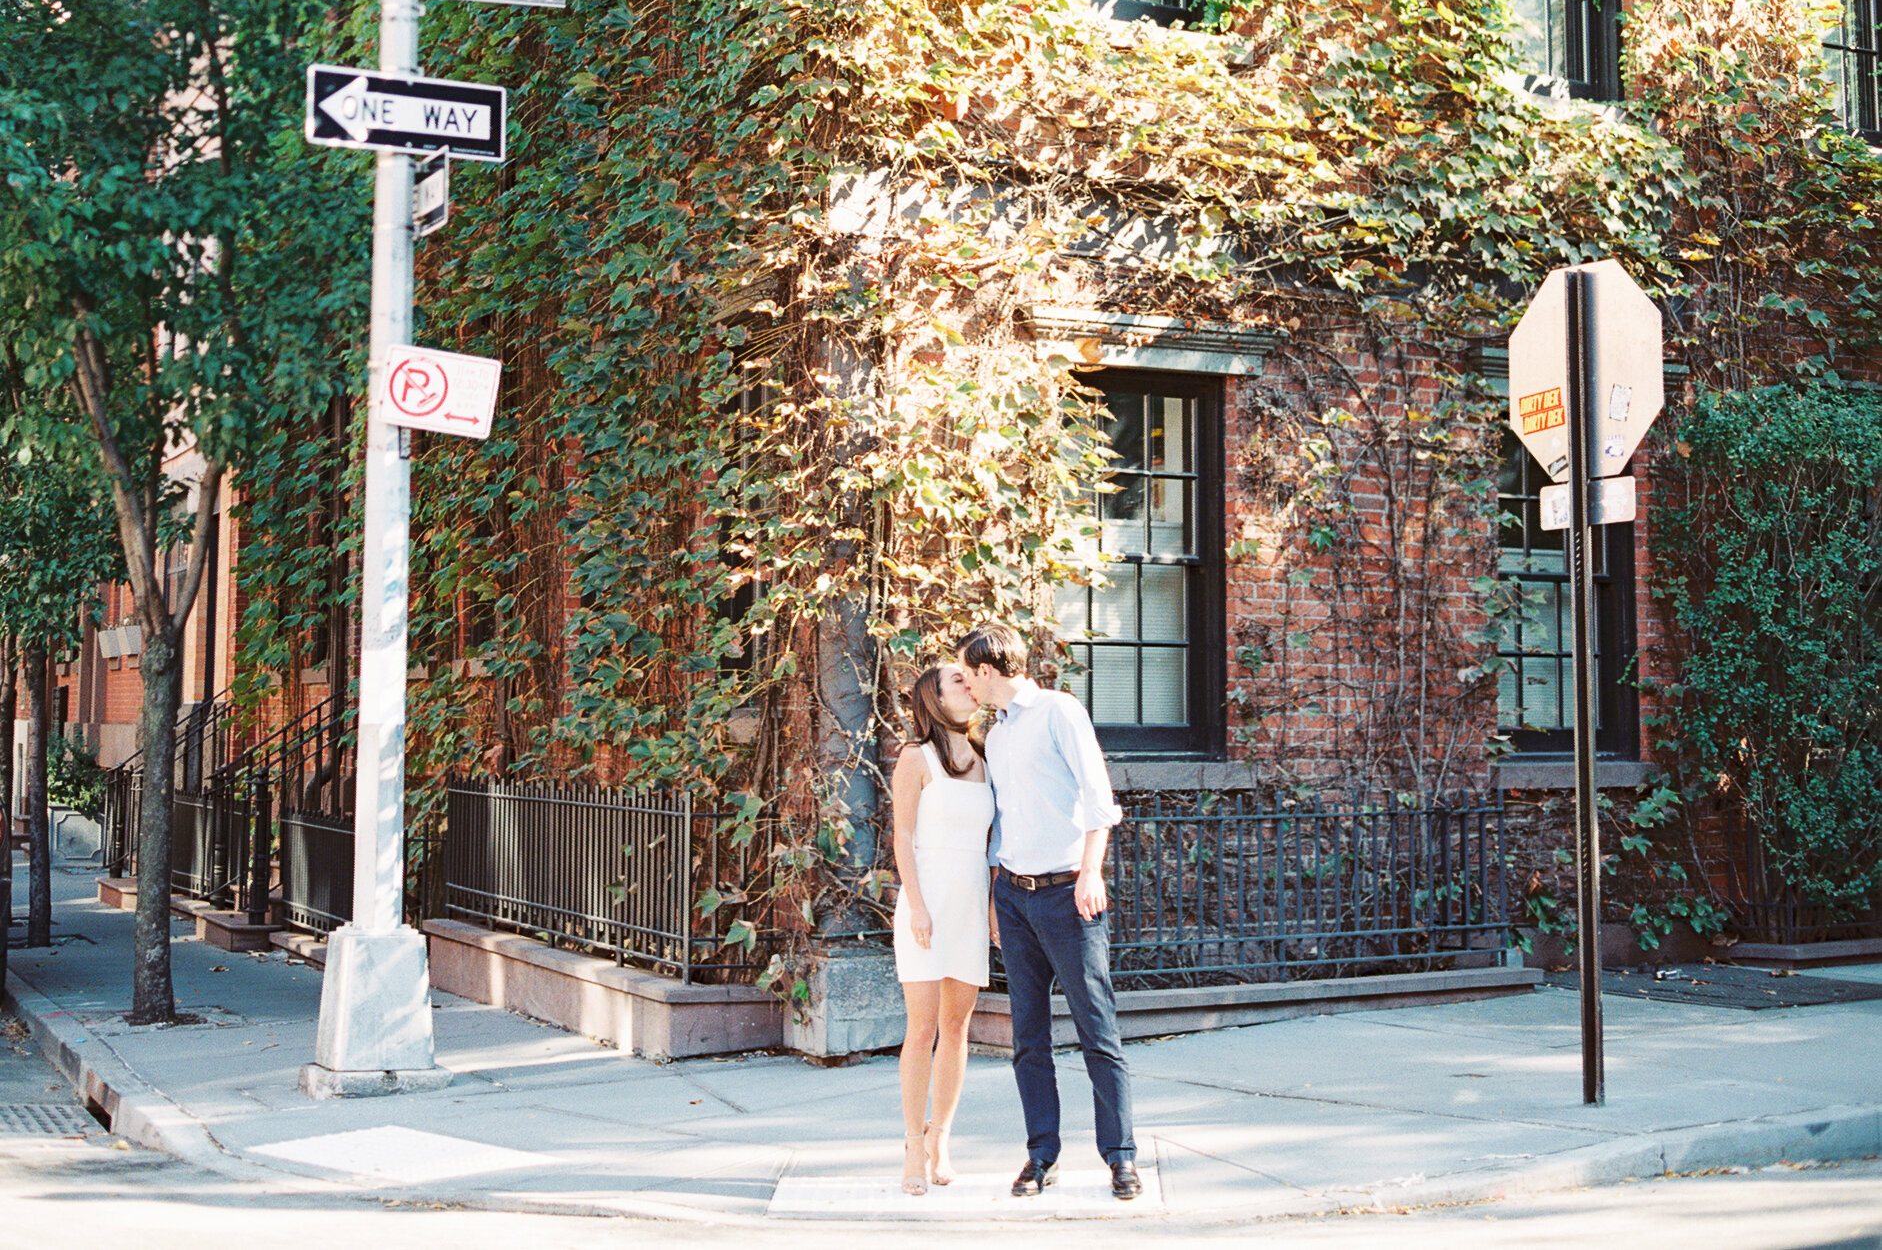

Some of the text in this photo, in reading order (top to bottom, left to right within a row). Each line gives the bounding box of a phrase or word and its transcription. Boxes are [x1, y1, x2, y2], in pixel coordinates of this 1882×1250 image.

[342, 95, 477, 133] ONE WAY
[1520, 393, 1544, 414] DIRTY
[1523, 412, 1547, 432] DIRTY
